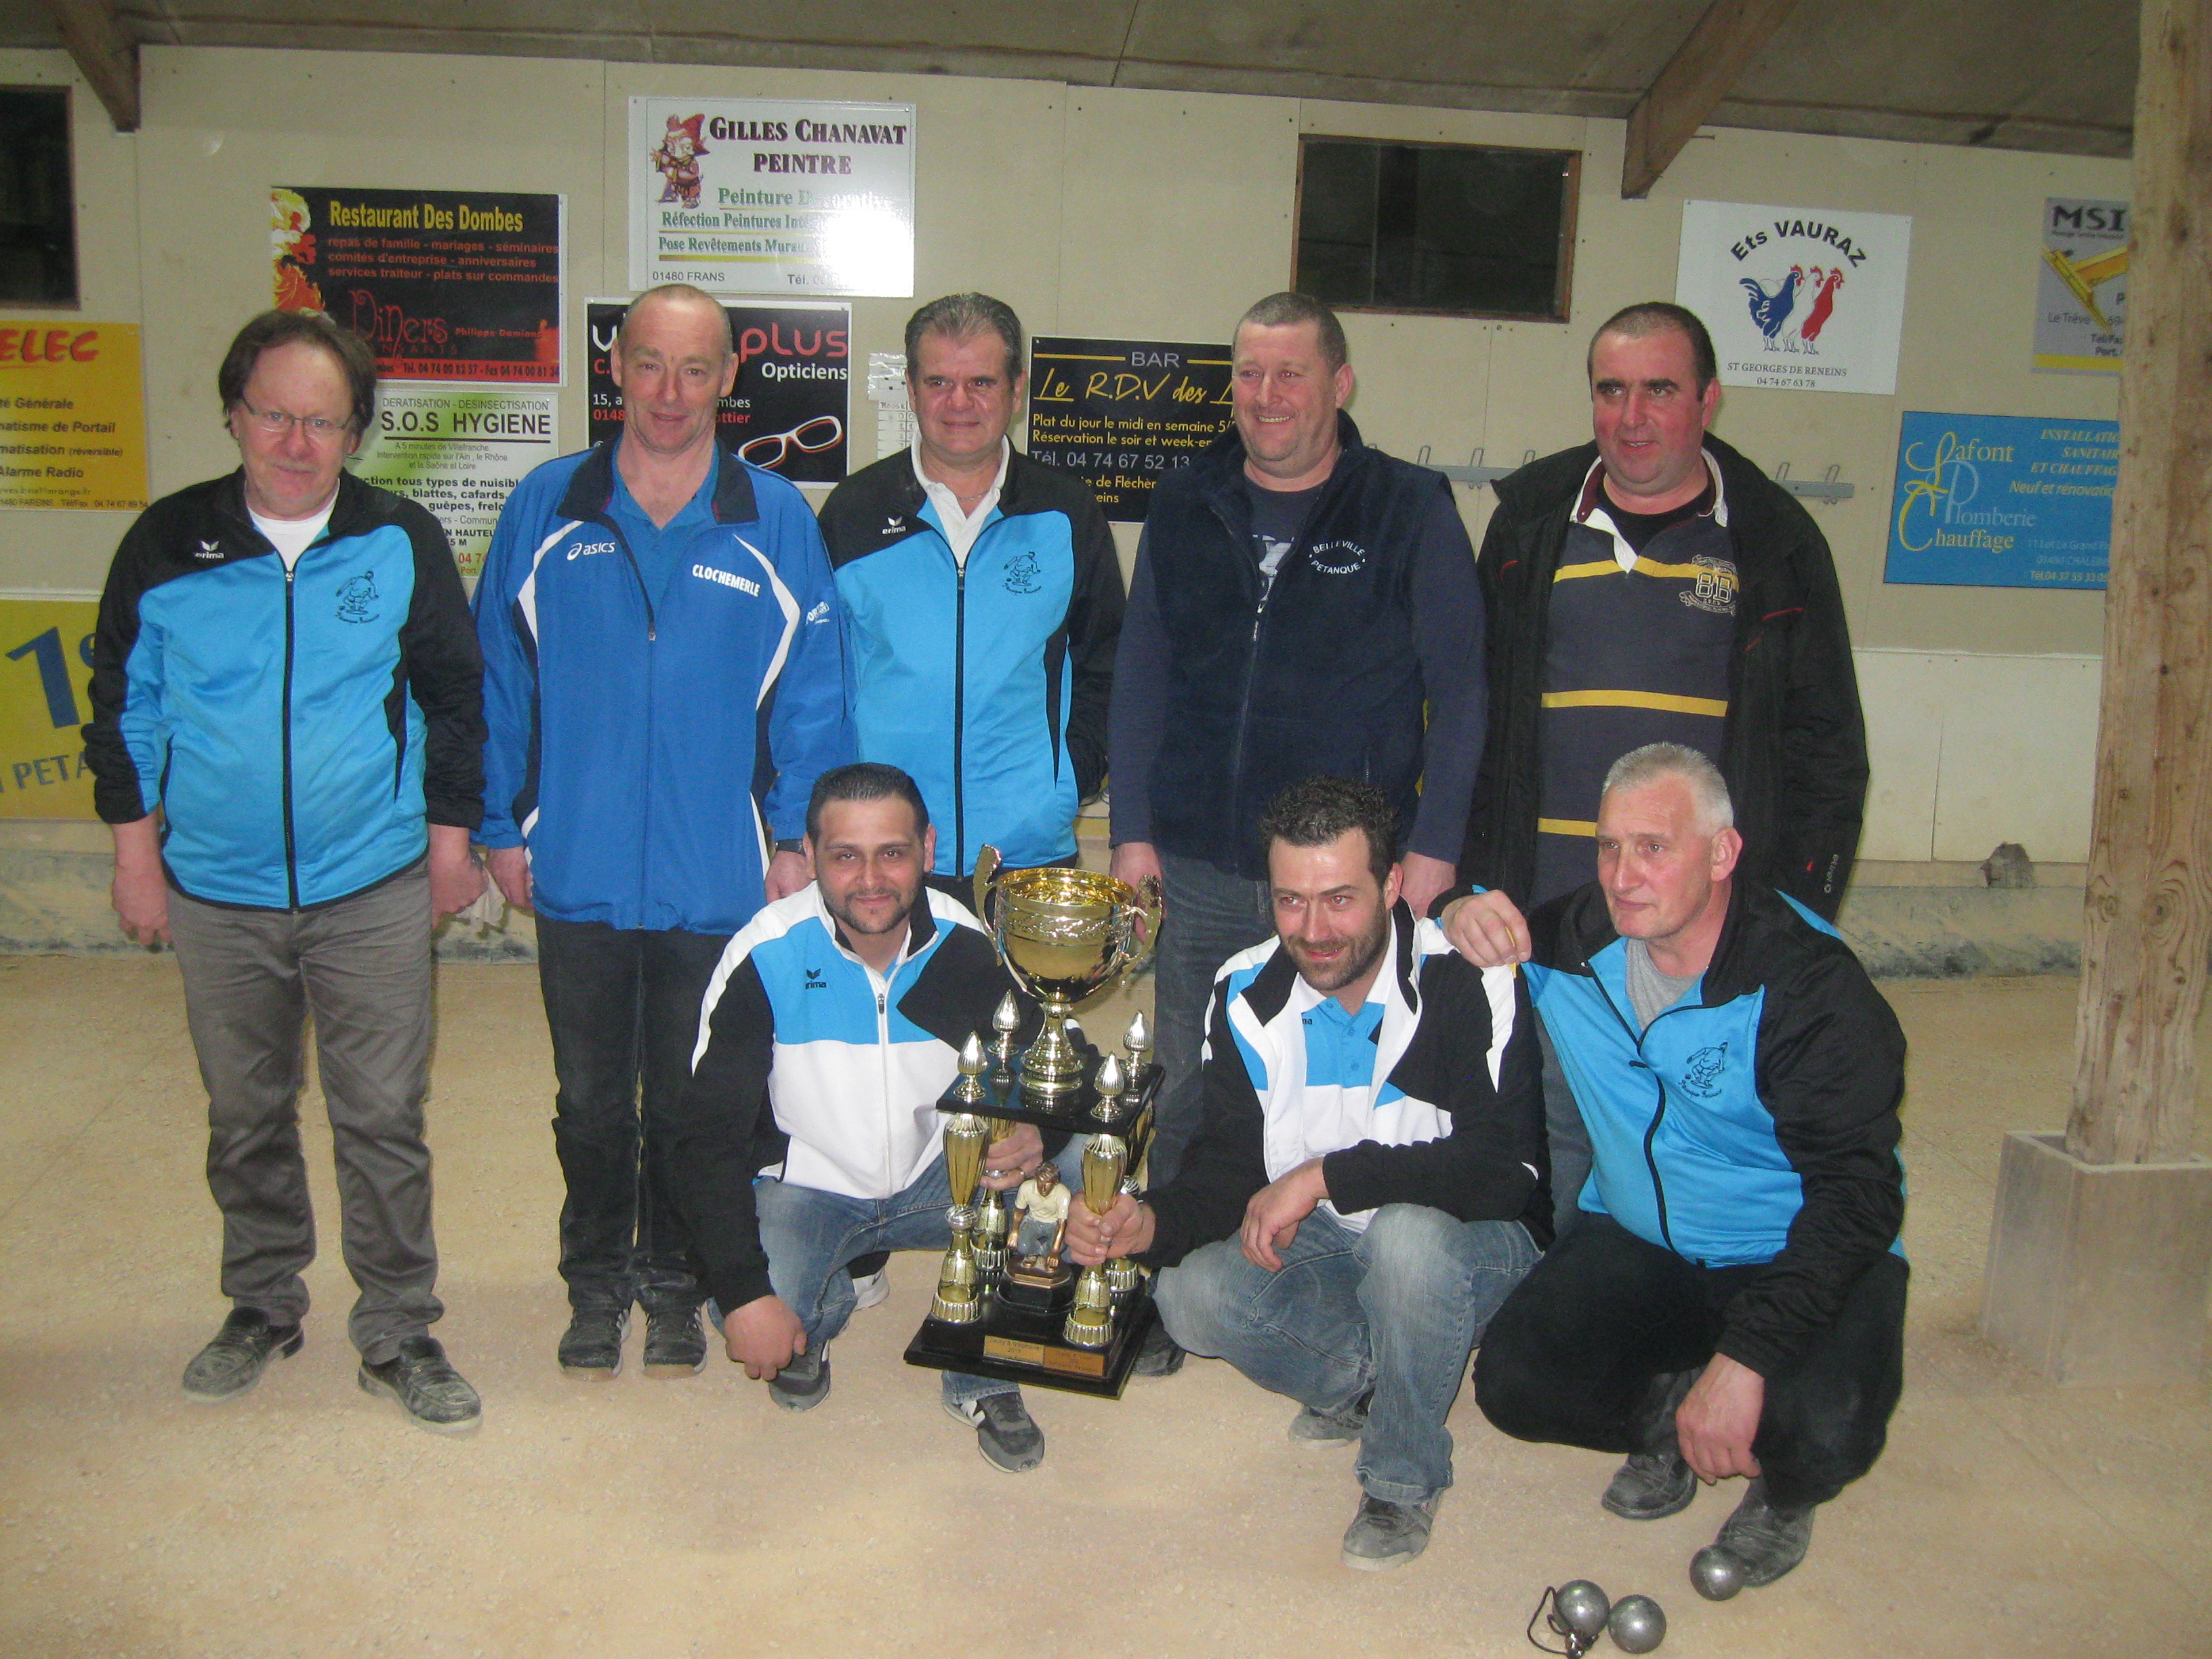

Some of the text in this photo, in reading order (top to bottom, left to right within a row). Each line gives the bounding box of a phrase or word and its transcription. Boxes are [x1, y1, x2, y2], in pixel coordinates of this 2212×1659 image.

[710, 117, 907, 145] GILLES CHANAVAT
[754, 152, 852, 175] PEINTRE
[718, 187, 793, 206] Peinture
[330, 201, 524, 232] Restaurant Des Dombes
[662, 211, 781, 229] Réfection Peintures
[328, 239, 559, 253] repas de famille mariages séminaires
[659, 237, 685, 251] Pose
[689, 237, 762, 253] Revêtements
[1730, 220, 1866, 268] Ets VAURAZ
[328, 252, 537, 268] comités d'entreprise anniversaires
[328, 268, 377, 277] services
[380, 268, 423, 279] traiteur
[434, 270, 462, 281] plats
[489, 272, 559, 283] commandes
[652, 272, 808, 285] 01480 FRANS Tél.
[348, 290, 448, 358] Diners
[740, 322, 848, 363] plus
[1131, 352, 1180, 368] BAR
[762, 362, 848, 382] Opticiens
[1727, 363, 1847, 377] ST GEORGES DE RENEINS
[1033, 368, 1074, 402] Le
[1172, 376, 1208, 403] des
[1757, 377, 1767, 386] 04
[1769, 377, 1780, 386] 74
[1781, 378, 1791, 386] 67
[1805, 379, 1816, 388] 78
[14, 398, 74, 409] Générale
[383, 398, 548, 411] DERATISATION DESINSECTISATION
[593, 394, 611, 408] 15,
[716, 396, 751, 409] mbes
[382, 411, 551, 434] S.O.S HYGIENE
[593, 409, 625, 421] 0148
[53, 421, 116, 434] de Portail
[1033, 414, 1214, 432] Plat du jour le midi en semaine
[1033, 430, 1157, 446] Réservation le soir et
[1031, 451, 1189, 469] Tél. 04 74 67 52 13
[47, 466, 84, 478] Radio
[362, 476, 518, 489] ction tous types de nuisibl
[1096, 475, 1156, 489] de Fléchèr
[2009, 480, 2043, 494] Neuf
[413, 489, 457, 499] blattes,
[1095, 494, 1119, 503] eins
[429, 500, 474, 512] guêpes,
[460, 516, 497, 525] Commun
[455, 529, 493, 537] HAUTEU
[882, 525, 906, 535] erima
[195, 551, 224, 560] erima
[583, 542, 615, 556] asics
[458, 553, 471, 564] 04
[1311, 559, 1361, 575] PETANQUE
[692, 564, 760, 597] CLOCHEMERLE
[13, 752, 89, 790] PETA
